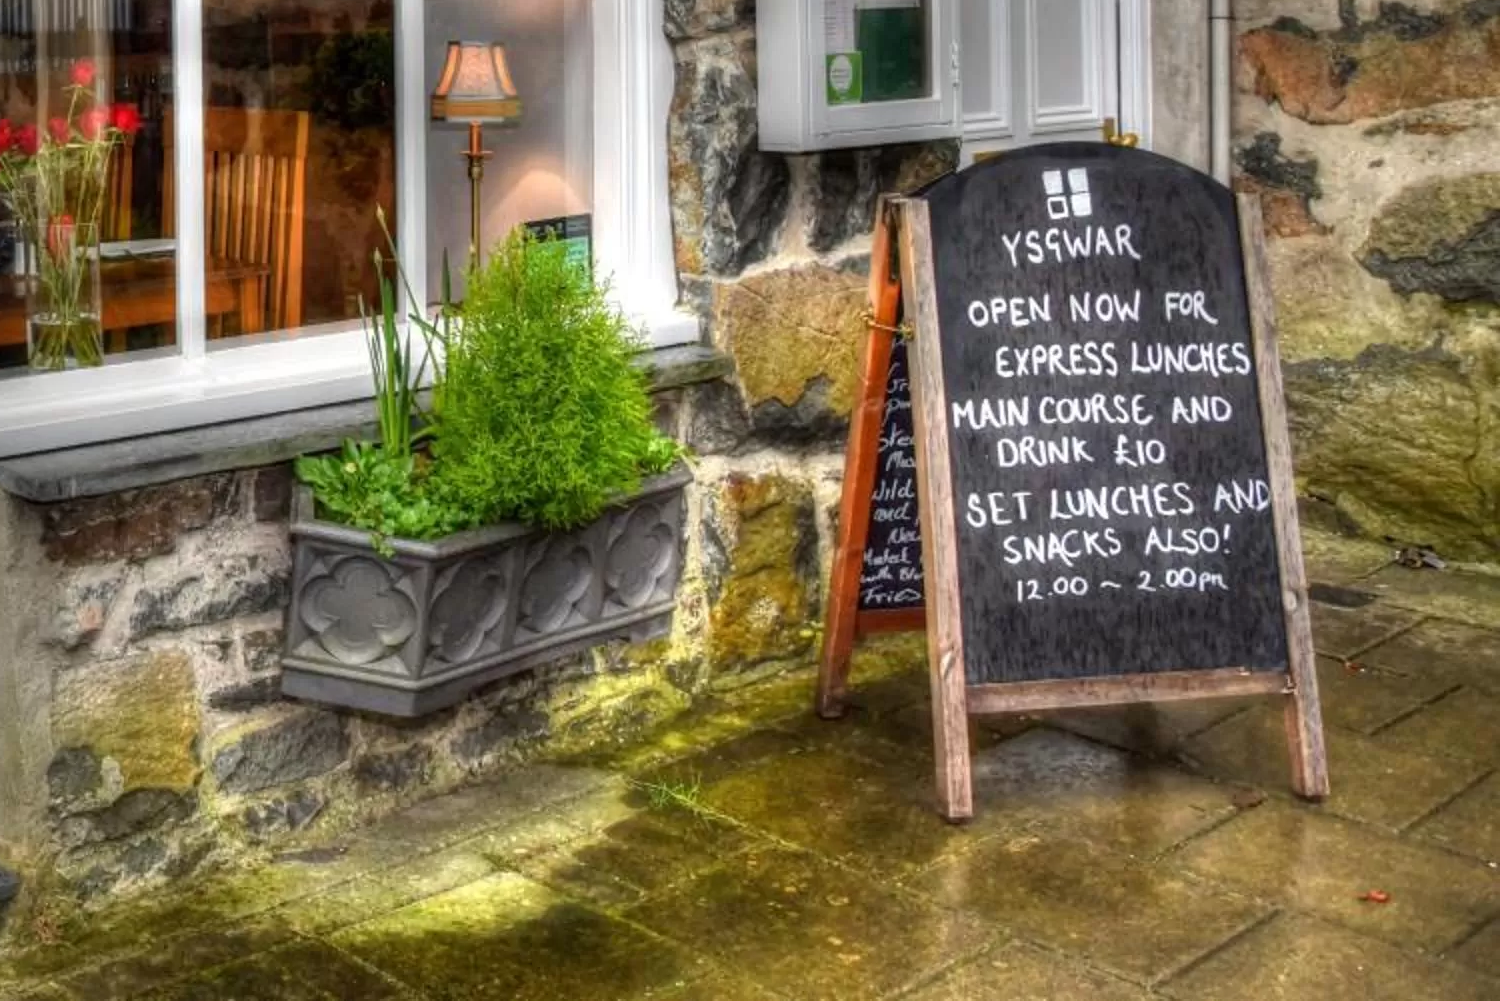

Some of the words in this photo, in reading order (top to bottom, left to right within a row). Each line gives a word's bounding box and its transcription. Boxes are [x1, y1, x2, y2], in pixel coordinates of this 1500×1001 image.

[967, 294, 1052, 328] OPEN
[1068, 289, 1142, 323] NOW
[1164, 290, 1219, 325] FOR
[995, 341, 1119, 378] EXPRESS
[1130, 341, 1252, 378] LUNCHES
[951, 396, 1030, 430] MAIN
[1038, 393, 1154, 426] COURSE
[1170, 395, 1233, 425] AND
[996, 436, 1095, 468] DRINK
[1112, 433, 1167, 468] £10
[966, 491, 1034, 528] SET
[1049, 481, 1195, 520] LUNCHES
[1214, 478, 1270, 514] AND
[1002, 527, 1123, 567] SNACKS
[1144, 523, 1232, 556] ALSO!
[1016, 575, 1089, 603] 12.00
